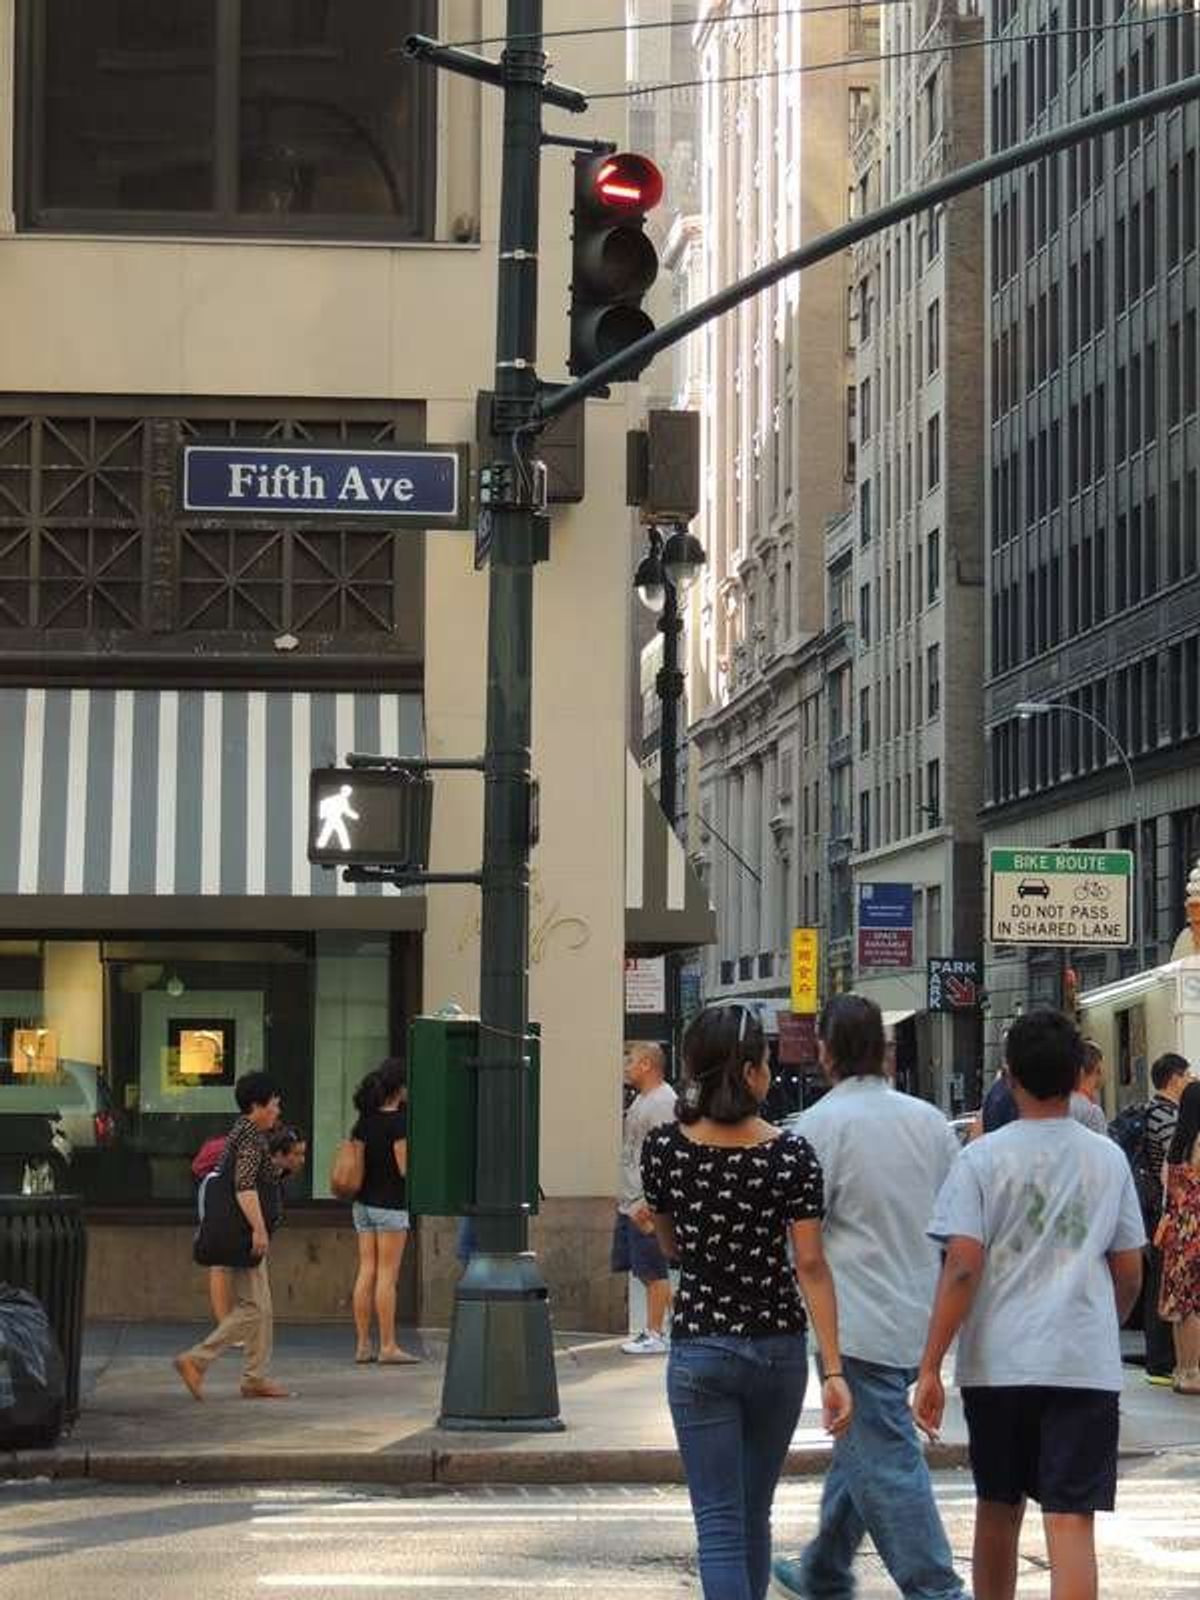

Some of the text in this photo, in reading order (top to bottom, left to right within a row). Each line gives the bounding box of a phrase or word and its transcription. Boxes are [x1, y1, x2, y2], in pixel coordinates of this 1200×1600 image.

[228, 463, 415, 501] Fifth Ave
[1014, 855, 1106, 871] BIKE ROUTE
[1011, 904, 1109, 920] DO NOT PASS
[998, 922, 1121, 938] IN SHARED LANE
[930, 960, 976, 973] PARK
